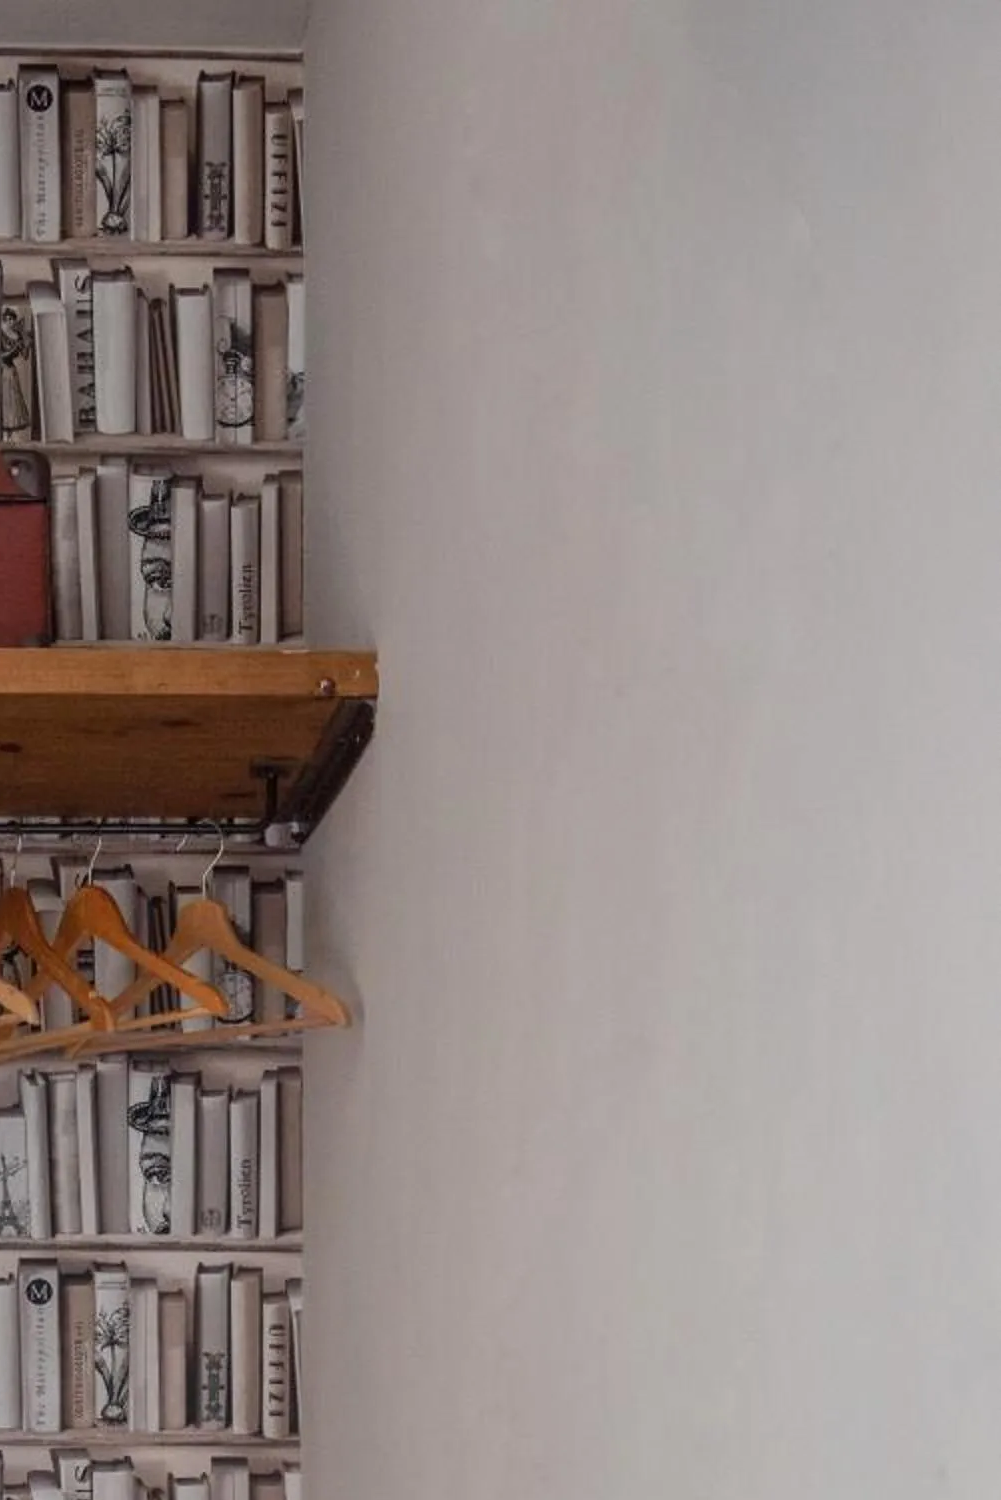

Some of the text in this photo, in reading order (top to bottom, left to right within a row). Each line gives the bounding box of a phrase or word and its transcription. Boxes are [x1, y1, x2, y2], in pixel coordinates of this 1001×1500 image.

[28, 86, 52, 111] M
[271, 133, 288, 228] UFFIZI
[237, 564, 255, 635] Tyrolien
[236, 1158, 253, 1229] Tyrolien
[27, 1279, 52, 1304] M
[269, 1323, 286, 1418] UFFIZI
